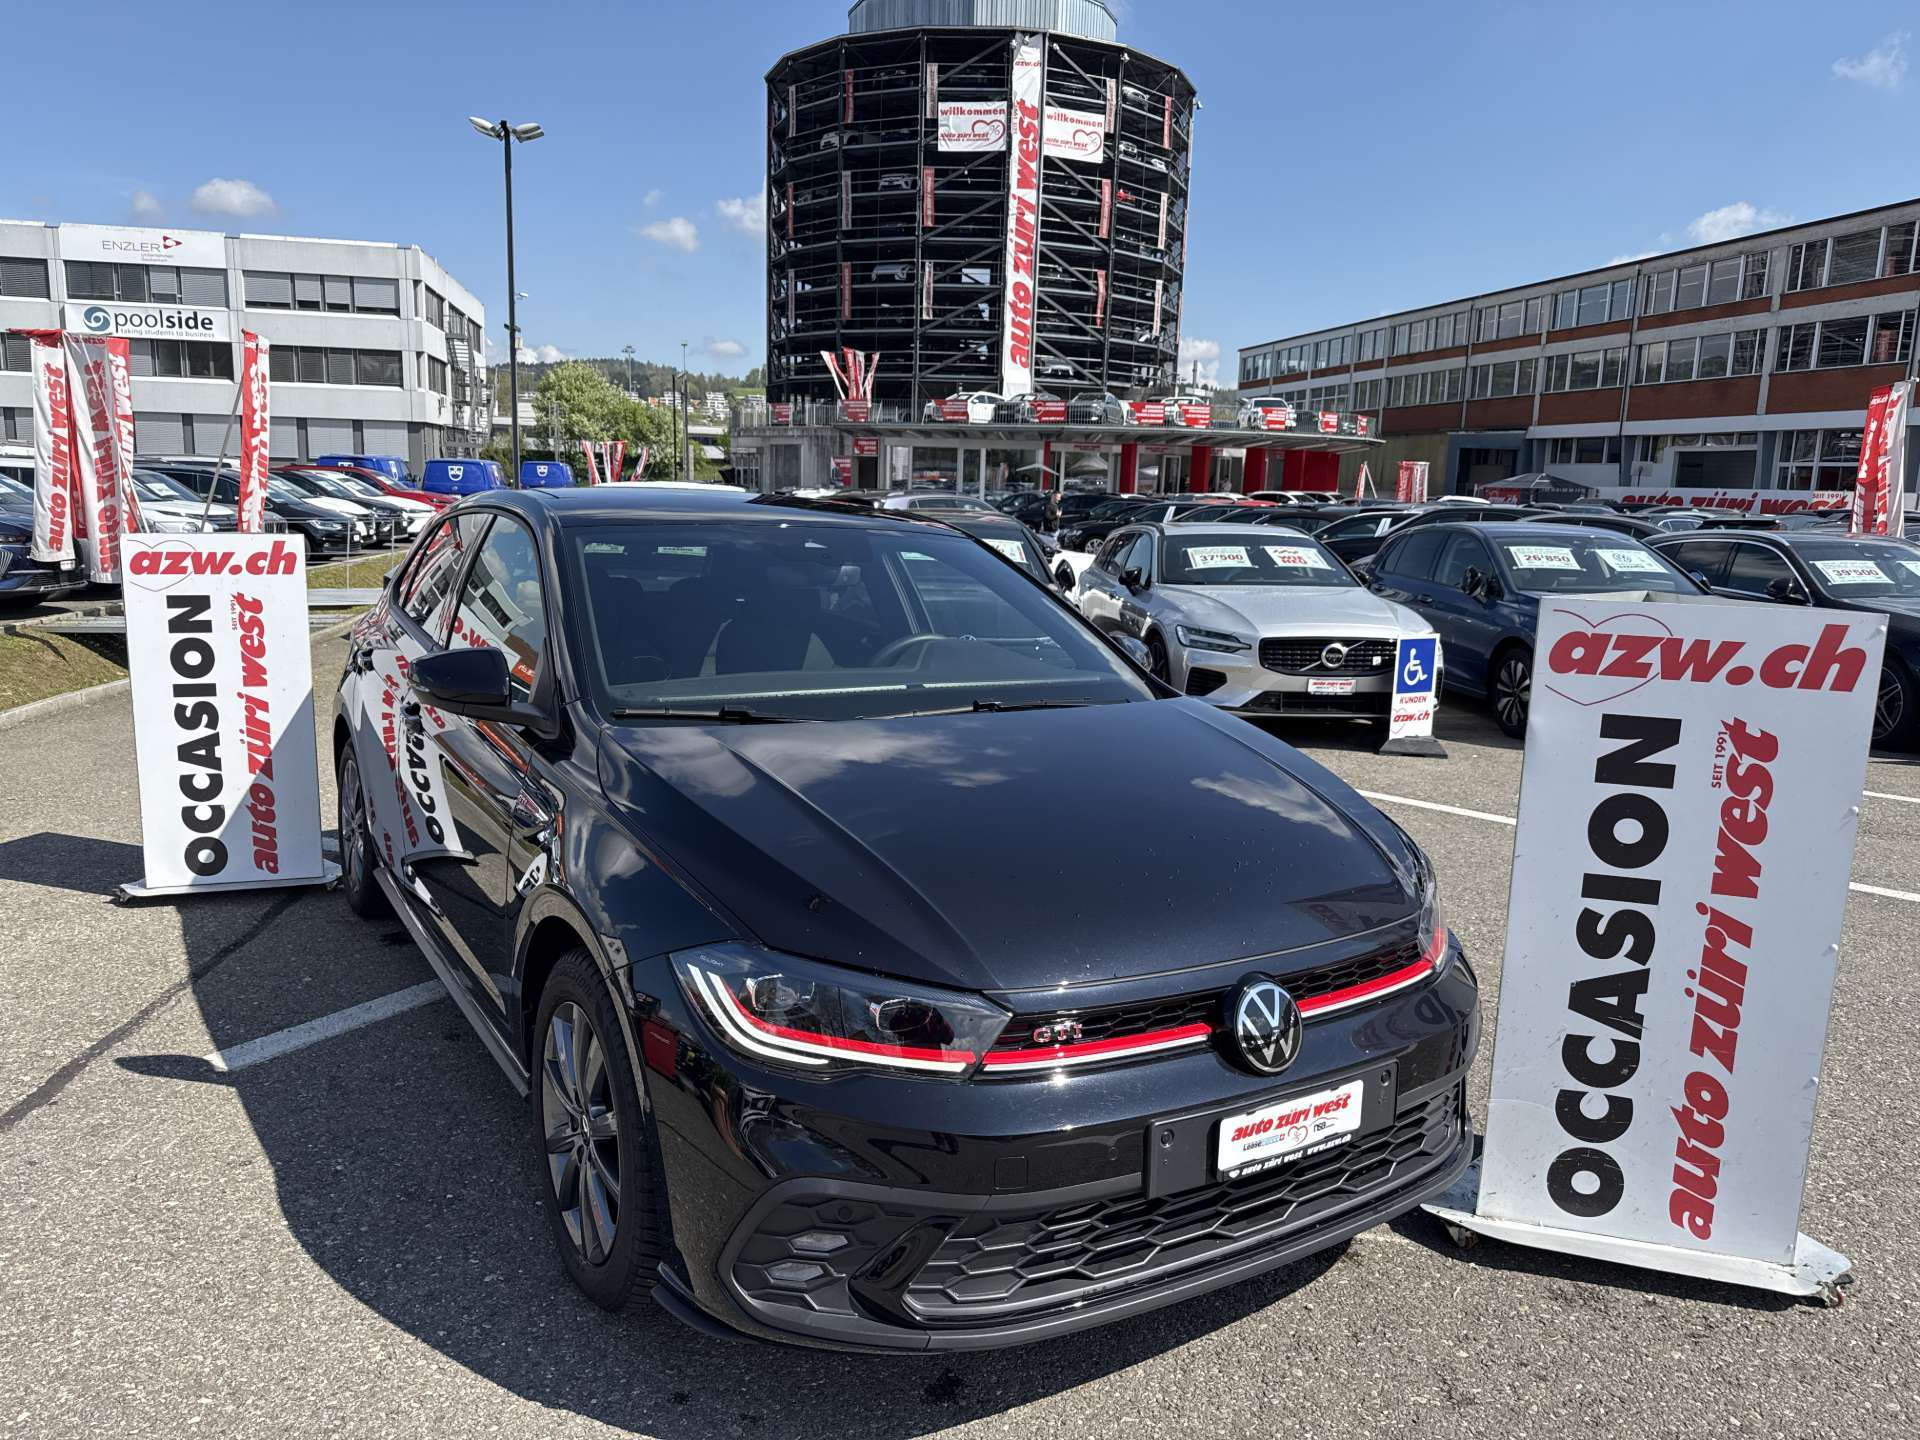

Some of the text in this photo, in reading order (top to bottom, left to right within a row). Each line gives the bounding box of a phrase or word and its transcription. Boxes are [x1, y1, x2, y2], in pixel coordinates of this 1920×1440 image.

[940, 105, 1006, 116] willkommen
[1046, 112, 1103, 128] willkommen
[102, 240, 161, 253] ENZLER
[1009, 98, 1039, 369] auto züri west
[114, 309, 213, 333] poolside
[121, 327, 143, 335] taking
[185, 330, 215, 339] business
[44, 362, 69, 552] auto züri west
[129, 540, 297, 576] azw.ch
[1524, 554, 1571, 563] 26'850
[1833, 568, 1879, 576] 39'500
[1548, 624, 1868, 692] azw.ch
[1399, 695, 1428, 705] KUNDEN
[1393, 710, 1431, 723] azw.ch
[166, 594, 228, 877] OCCASION
[230, 592, 279, 874] auto züri west
[1711, 731, 1728, 789] SEIT 1991
[1547, 713, 1682, 1217] OCCASION
[1669, 717, 1779, 1240] auto züri west
[1033, 1022, 1083, 1043] GTI
[1231, 1118, 1274, 1142] auto
[1274, 1104, 1312, 1130] züri
[1313, 1092, 1352, 1118] west
